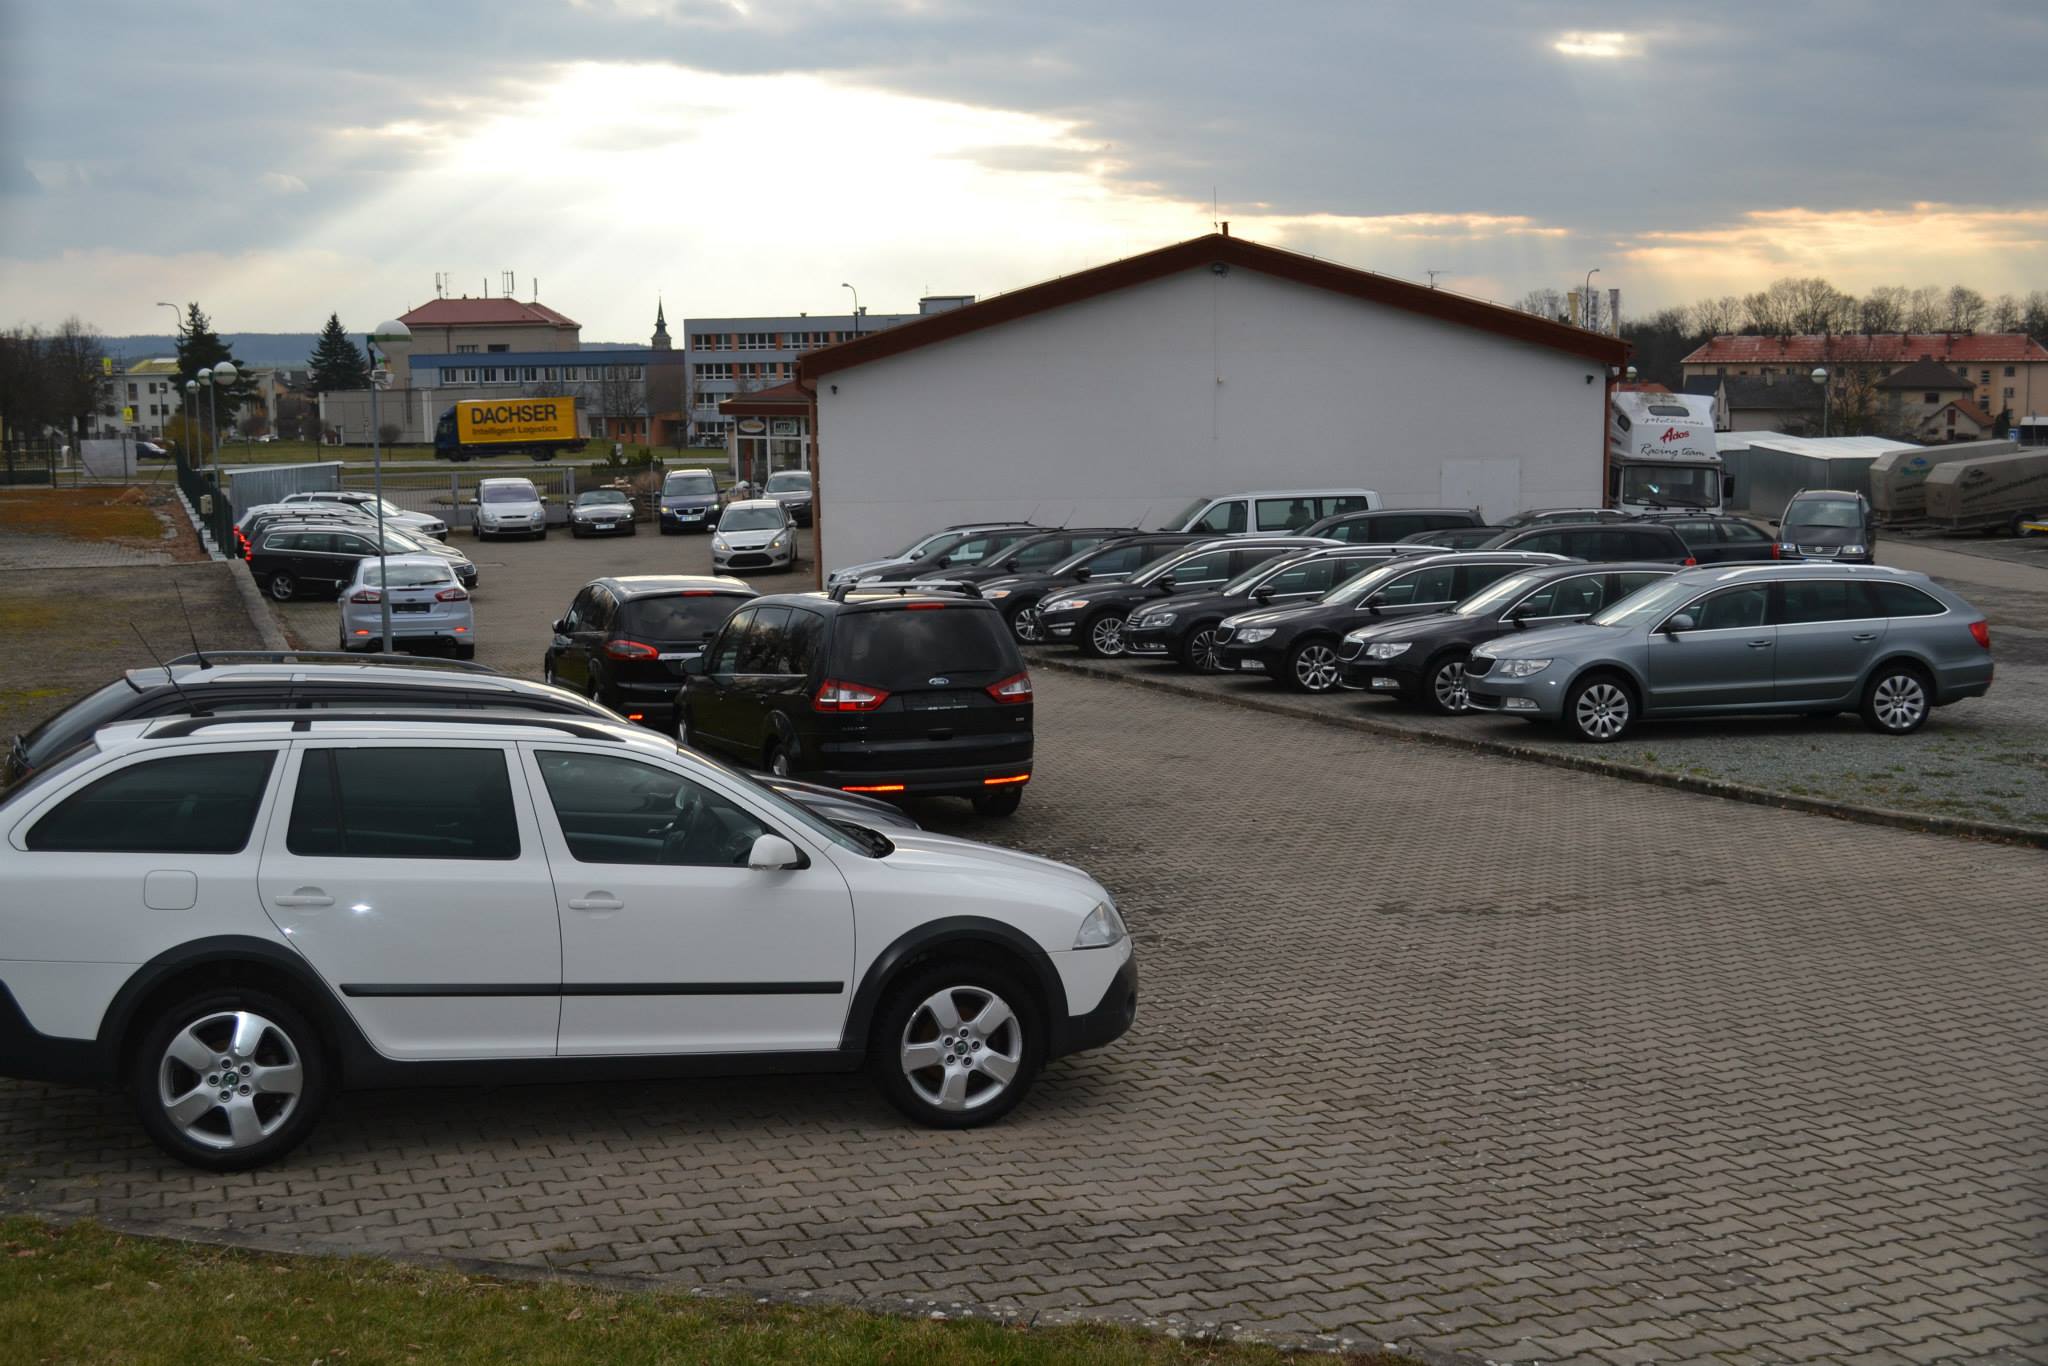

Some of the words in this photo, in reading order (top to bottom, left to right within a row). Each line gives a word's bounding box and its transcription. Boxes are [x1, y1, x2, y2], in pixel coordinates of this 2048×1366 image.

[471, 404, 557, 424] DACHSER
[471, 428, 516, 436] Intelligent
[518, 425, 558, 434] Logistics
[1660, 427, 1690, 443] Ados
[1640, 443, 1678, 459] Racing
